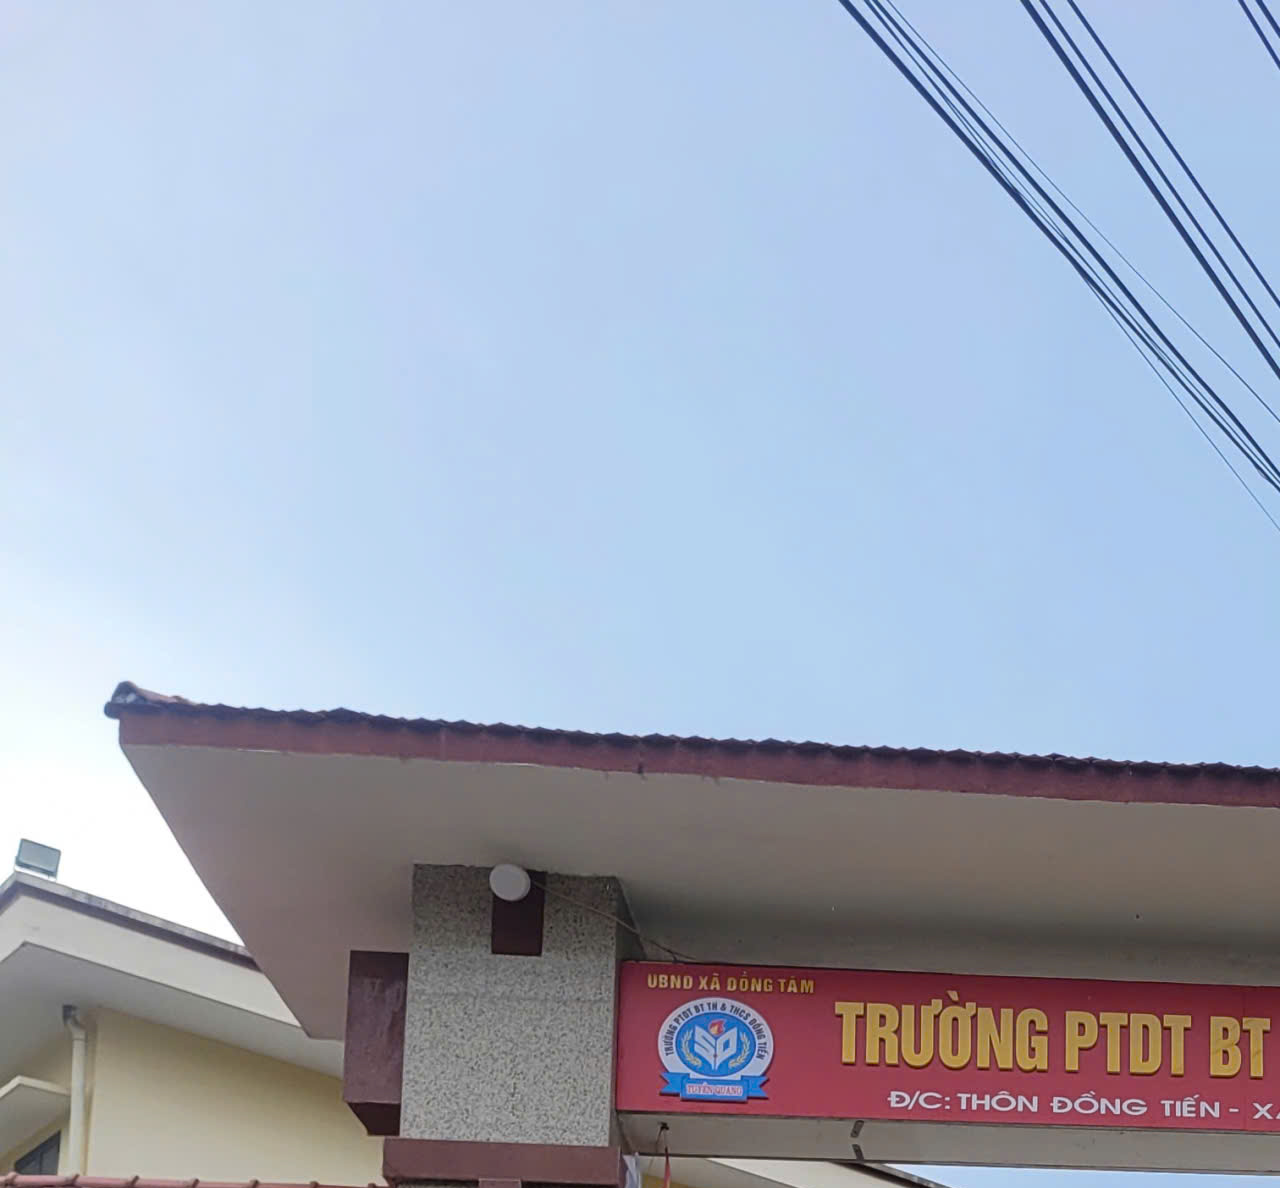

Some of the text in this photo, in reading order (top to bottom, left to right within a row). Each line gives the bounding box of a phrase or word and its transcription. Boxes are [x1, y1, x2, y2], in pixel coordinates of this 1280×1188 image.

[647, 973, 694, 990] UBND
[698, 973, 721, 991] XÃ
[694, 1003, 705, 1014] BT
[707, 1001, 718, 1011] TH
[720, 1002, 728, 1011] &
[835, 991, 1050, 1072] TRƯỜNG
[1064, 1011, 1193, 1077] PTDT
[1209, 1016, 1271, 1079] BT
[888, 1091, 951, 1111] Đ/C:
[957, 1090, 1039, 1113] THÔN
[1050, 1090, 1149, 1116] ĐỒNG
[1161, 1094, 1221, 1119] TIẾN
